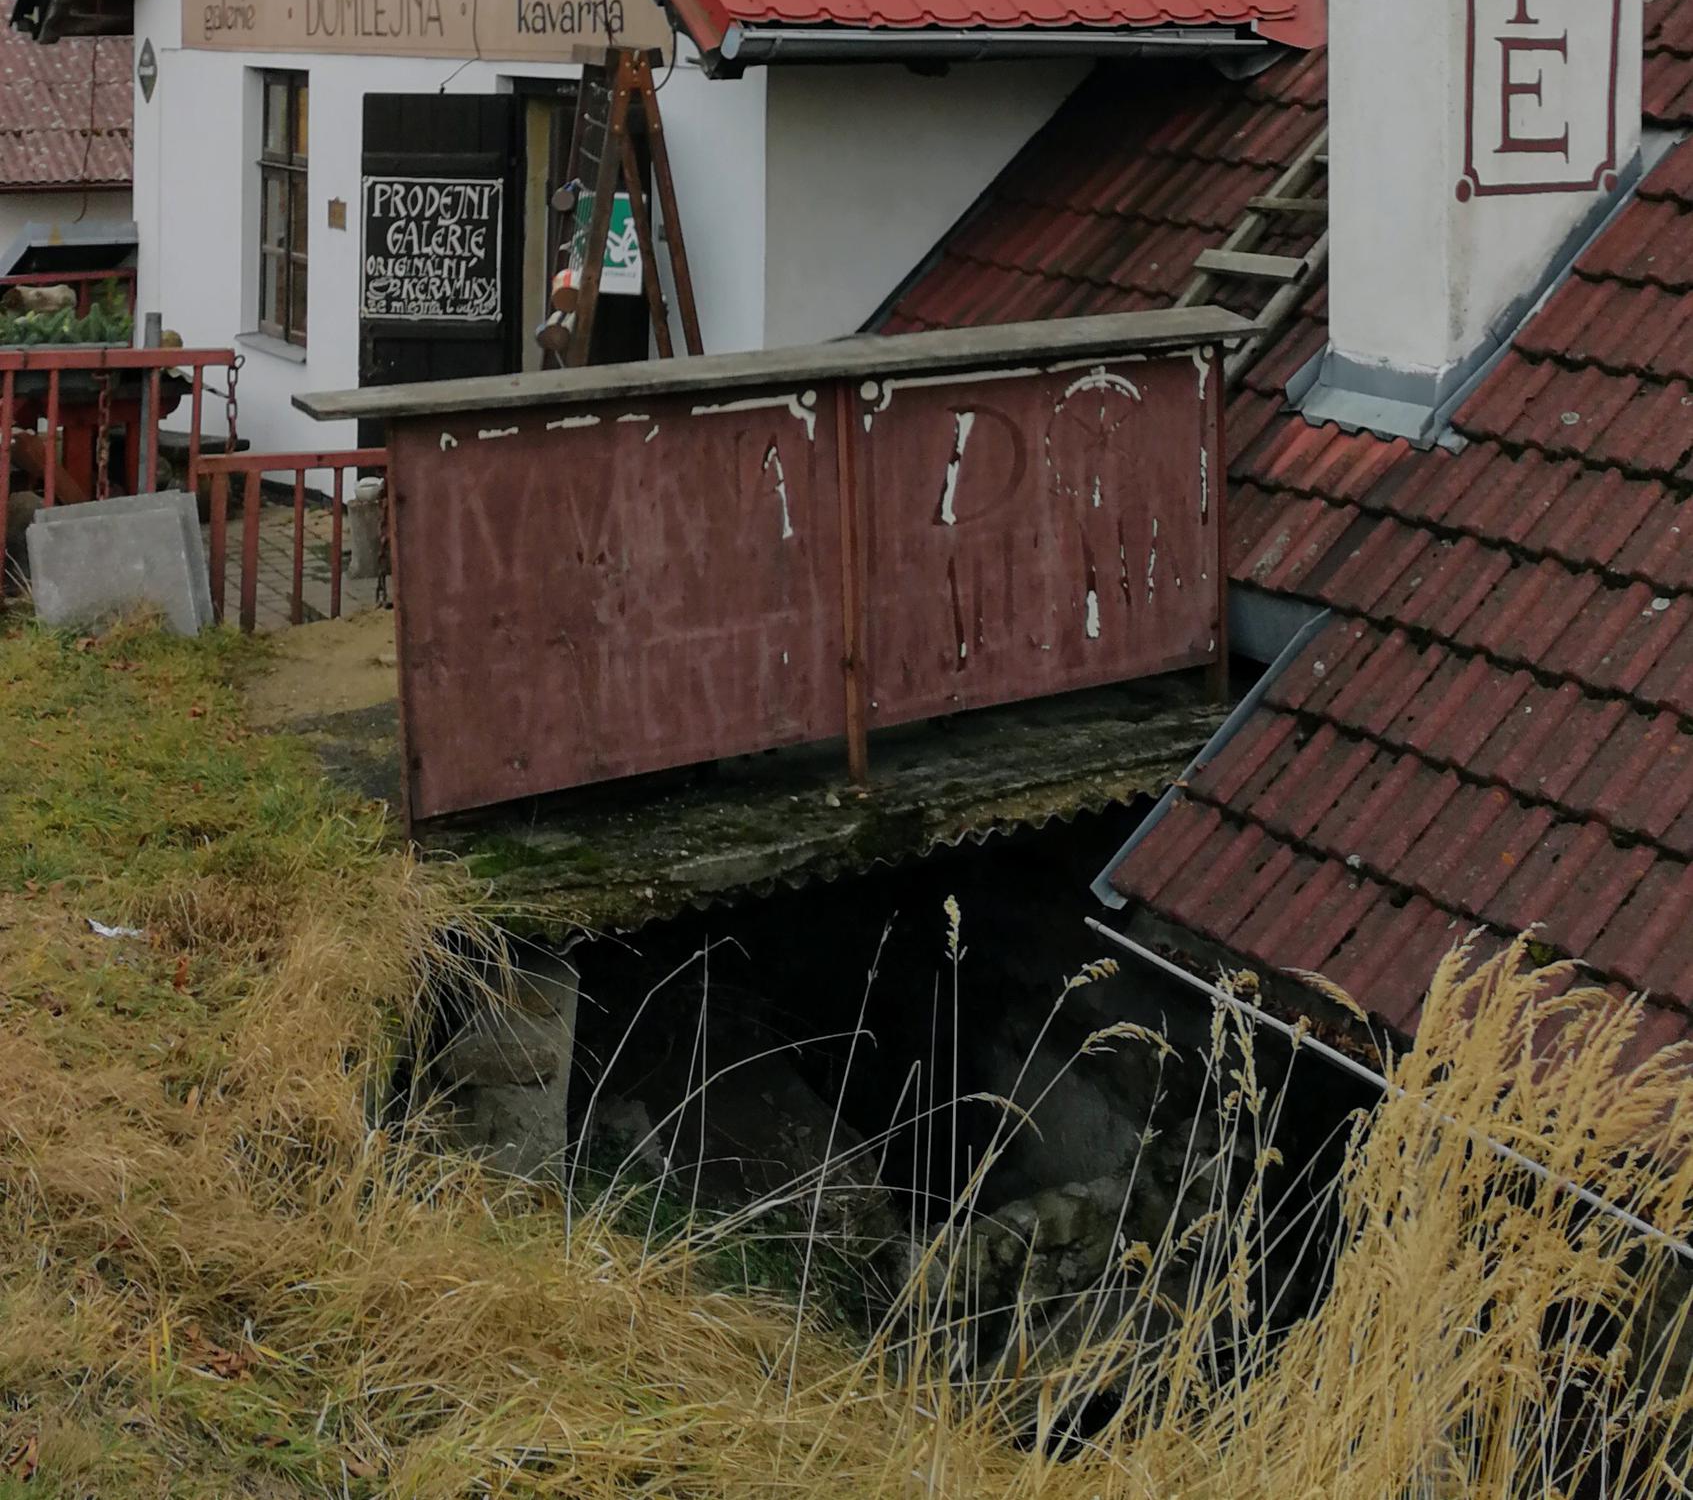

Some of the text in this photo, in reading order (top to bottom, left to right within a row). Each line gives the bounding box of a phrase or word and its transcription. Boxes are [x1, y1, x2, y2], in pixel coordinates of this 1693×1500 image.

[372, 183, 498, 226] PRODEJNÍ
[386, 218, 486, 259] GALERIE
[366, 254, 478, 284] ORIGINÁLNÍ
